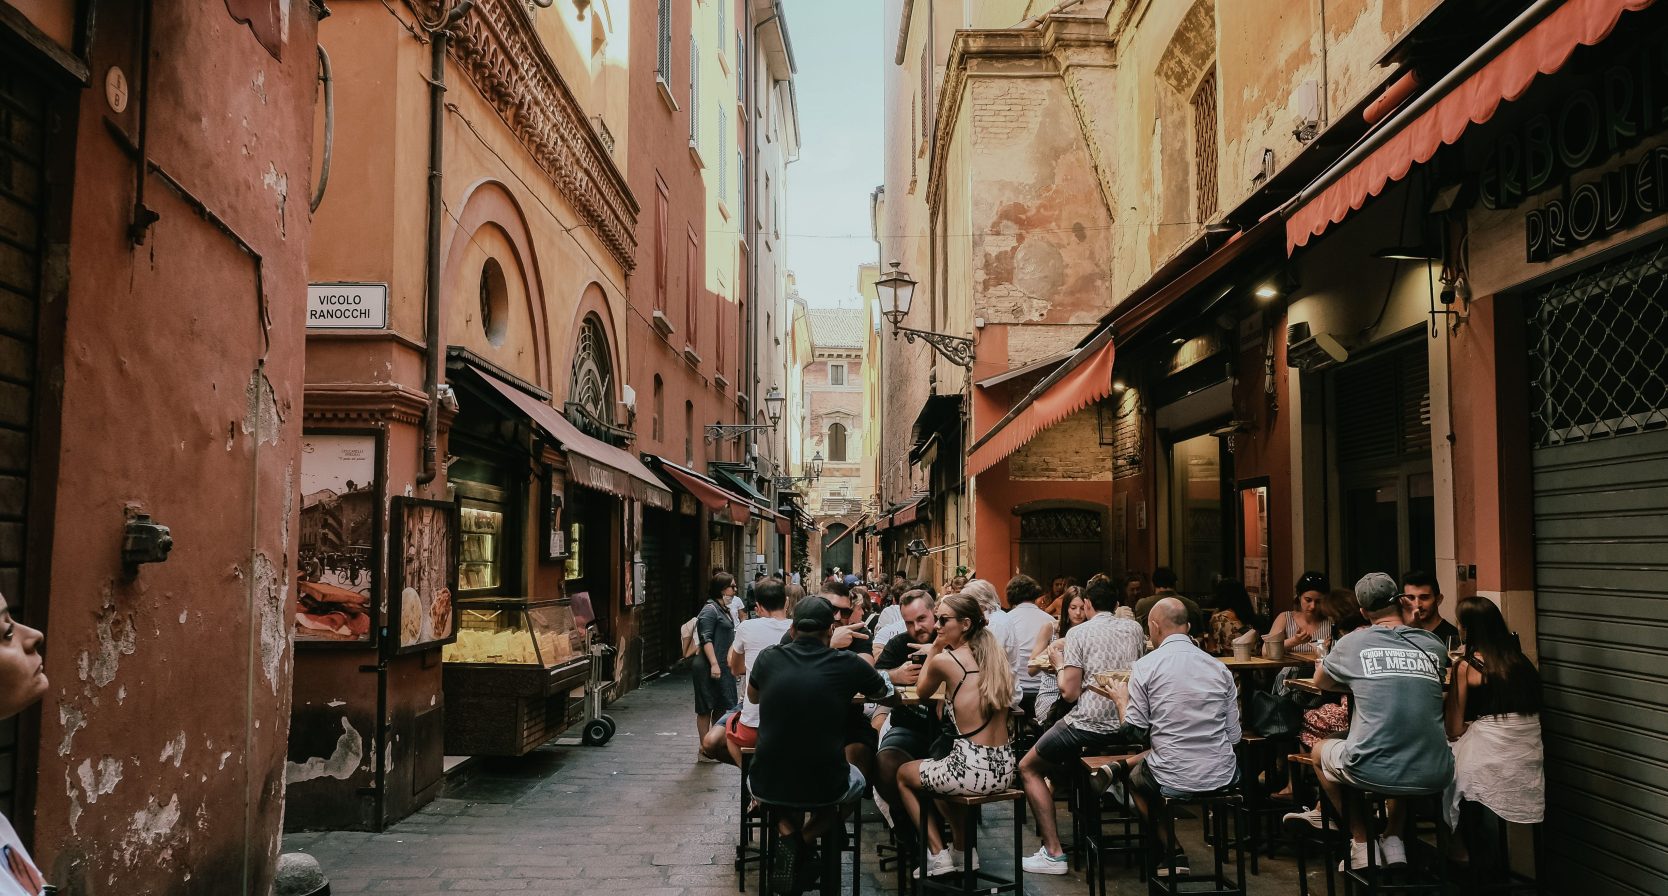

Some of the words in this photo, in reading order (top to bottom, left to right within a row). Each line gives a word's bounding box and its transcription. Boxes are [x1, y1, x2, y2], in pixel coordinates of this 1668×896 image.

[1480, 40, 1668, 209] ERBORI
[318, 294, 362, 306] VICOLO
[310, 308, 370, 320] RANOCCHI
[1384, 650, 1406, 658] WIND
[1365, 657, 1383, 672] EL
